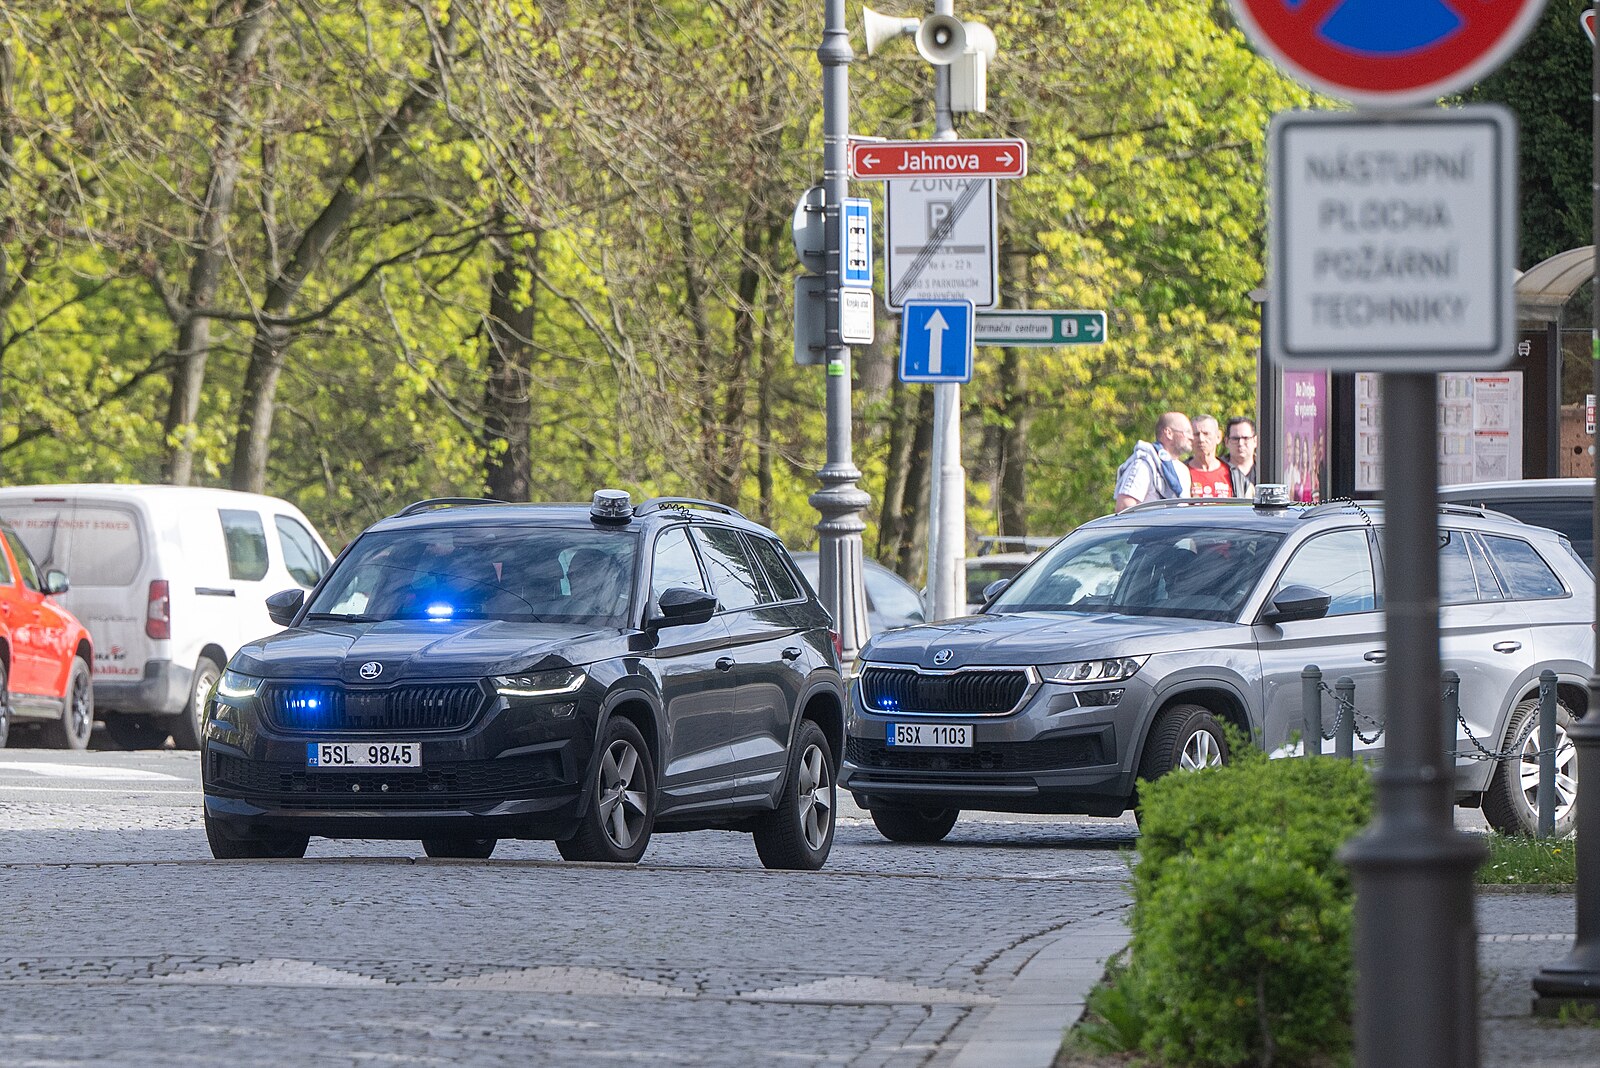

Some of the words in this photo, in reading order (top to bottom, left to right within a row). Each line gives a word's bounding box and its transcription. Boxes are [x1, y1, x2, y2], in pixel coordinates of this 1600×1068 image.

[897, 151, 979, 171] Jahnova
[1305, 143, 1475, 185] NÁSTUPNÍ
[1318, 198, 1453, 232] PLOCHA
[1313, 240, 1460, 282] POŽÁRNÍ
[1307, 292, 1470, 328] TECHNIKY
[975, 321, 1011, 333] formační
[1015, 323, 1048, 333] centrum
[897, 726, 921, 744] 5SX
[932, 727, 966, 745] 1103
[321, 745, 354, 764] 5SL
[368, 745, 412, 764] 9845
